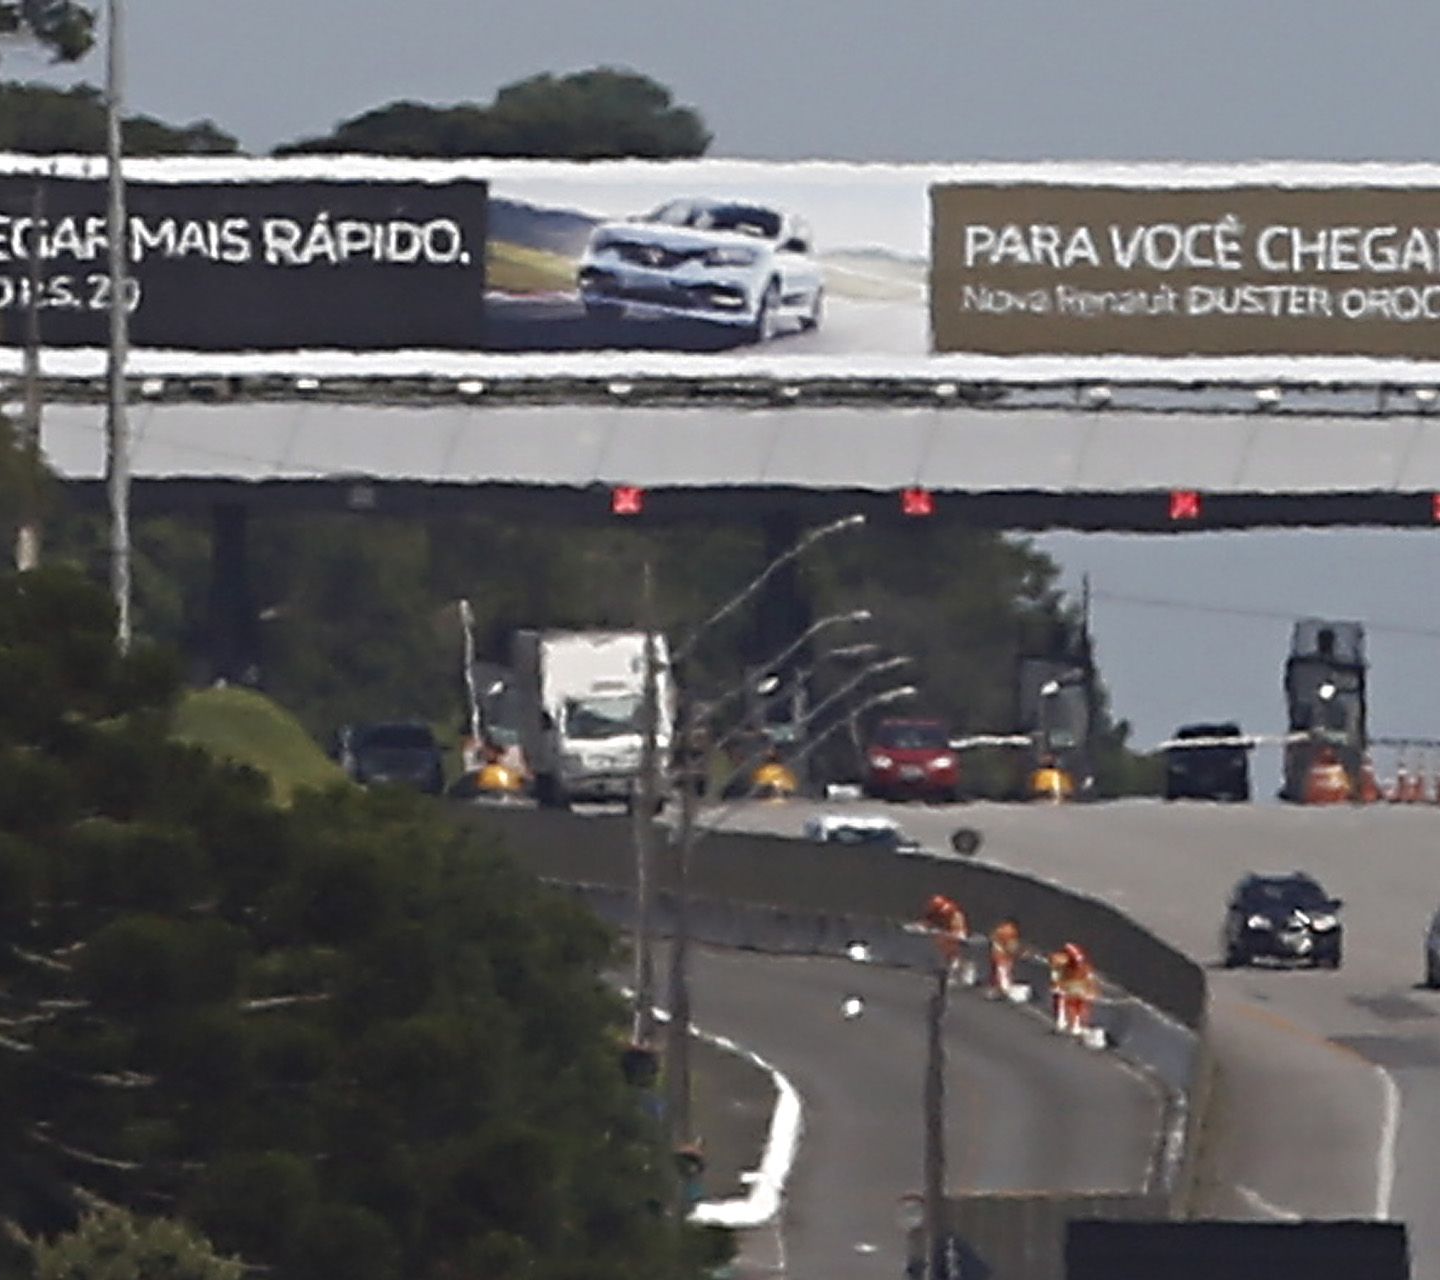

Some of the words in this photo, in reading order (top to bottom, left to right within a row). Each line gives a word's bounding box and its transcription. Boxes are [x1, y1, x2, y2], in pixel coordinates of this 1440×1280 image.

[130, 217, 252, 263] MAIS
[264, 211, 471, 264] RÁPIDO.
[964, 223, 1101, 268] PARA
[1109, 212, 1245, 270] VOCÊ
[1187, 285, 1332, 317] DUSTER
